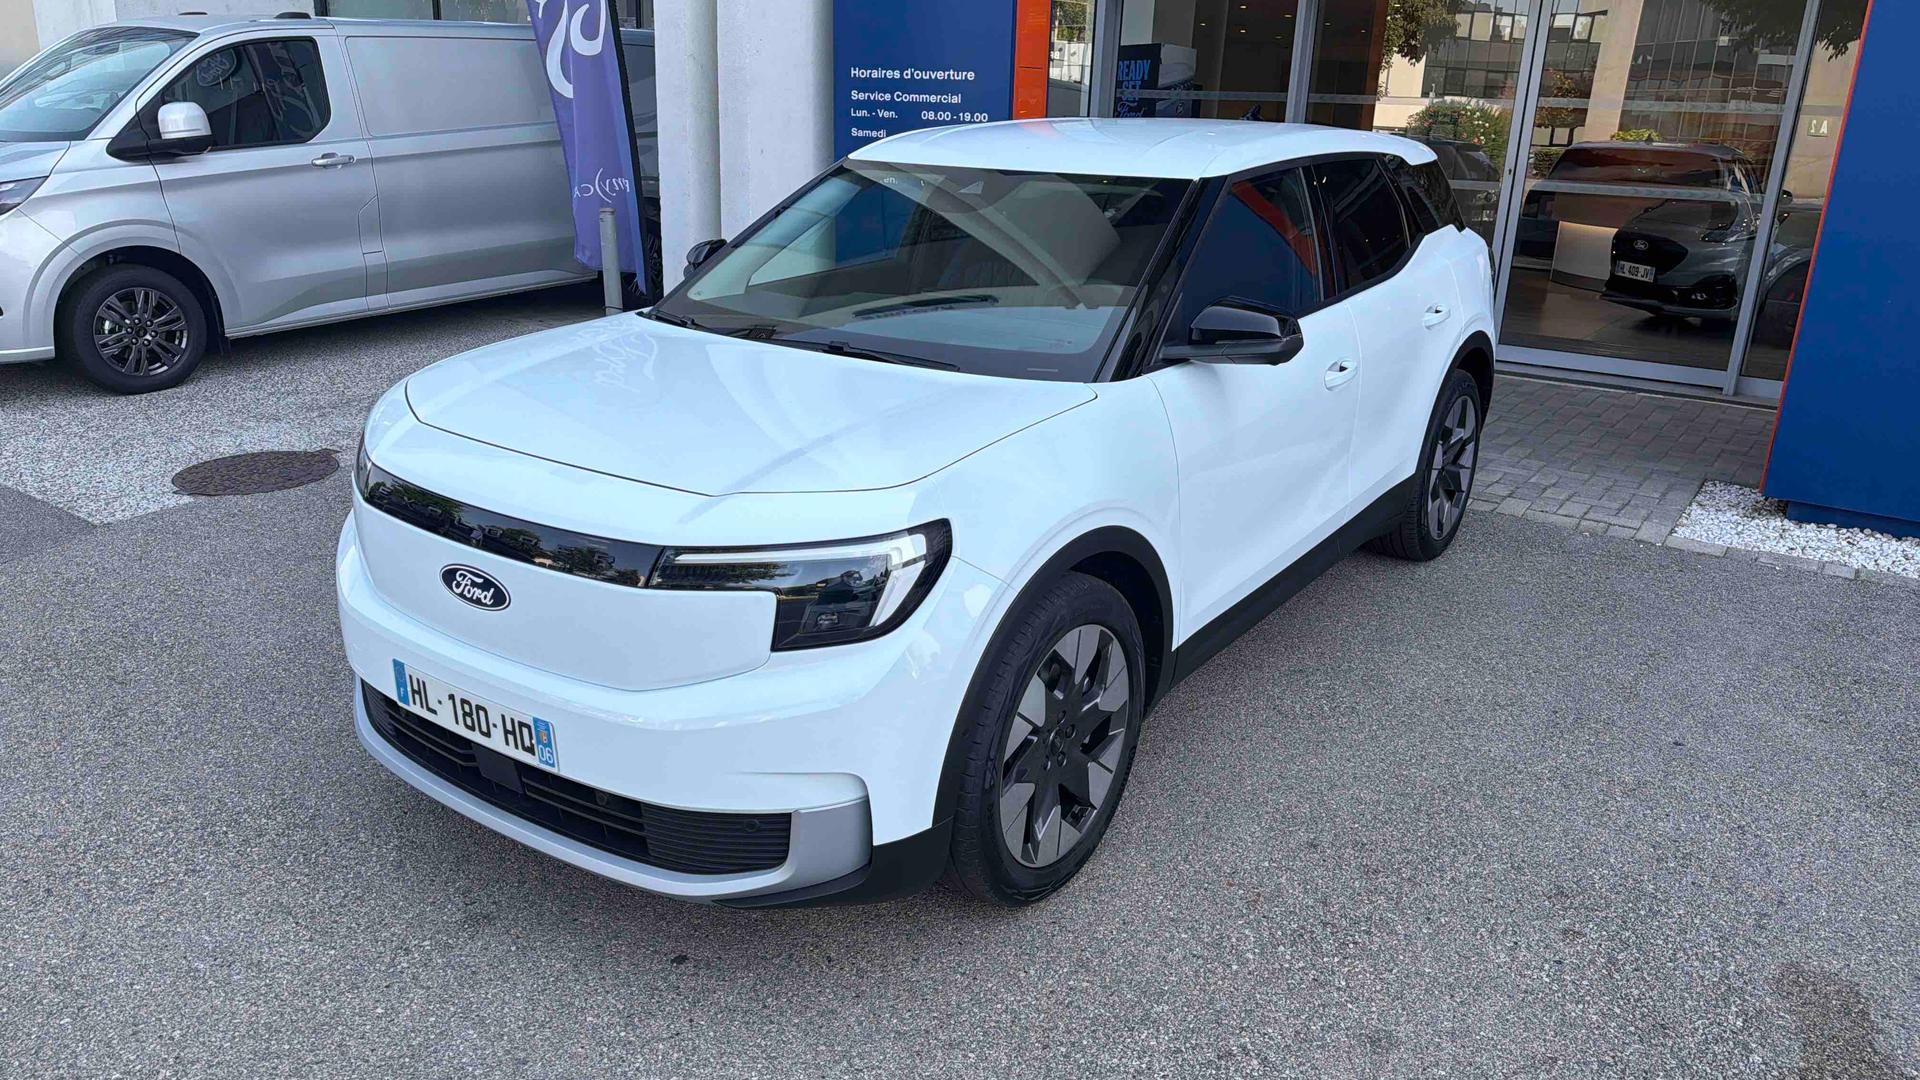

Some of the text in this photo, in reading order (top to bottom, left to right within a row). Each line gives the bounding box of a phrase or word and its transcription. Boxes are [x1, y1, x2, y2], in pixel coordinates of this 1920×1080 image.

[851, 67, 975, 81] Horaires d'ouverture
[1118, 60, 1151, 80] READY
[851, 90, 962, 104] Service Commercial
[851, 108, 871, 117] Lun.
[877, 109, 898, 118] Ven.
[921, 110, 951, 121] 08.00
[959, 112, 988, 122] 19.00
[851, 128, 887, 138] Samedi
[452, 570, 495, 605] Ford
[538, 744, 553, 764] 06
